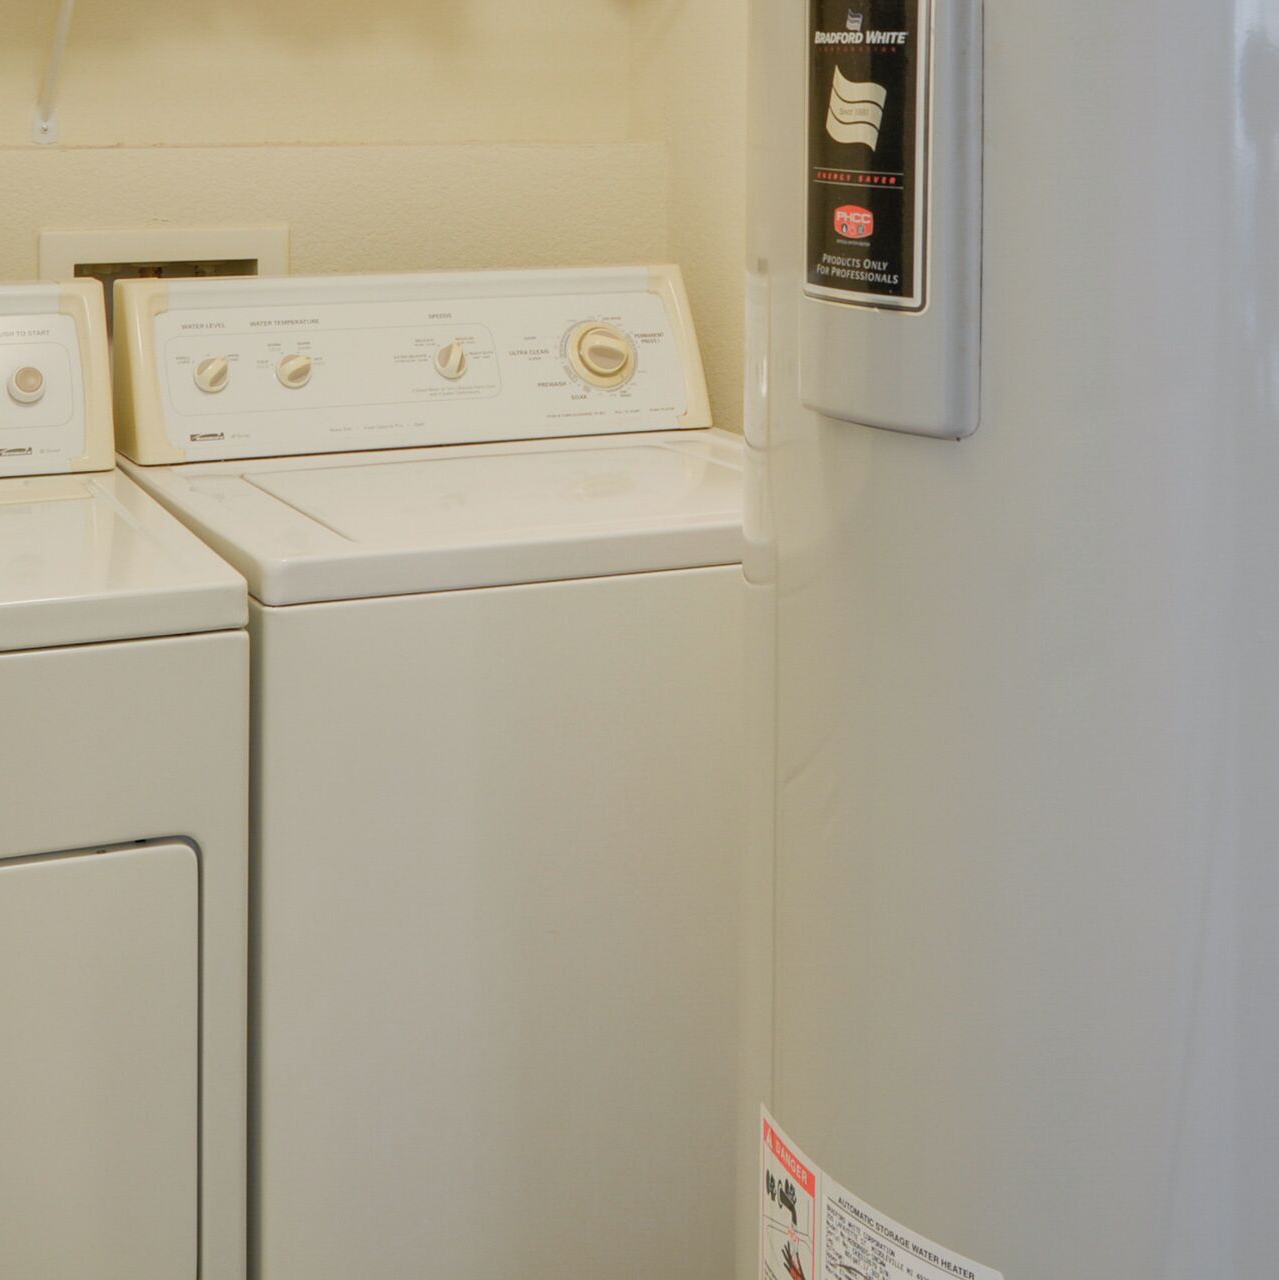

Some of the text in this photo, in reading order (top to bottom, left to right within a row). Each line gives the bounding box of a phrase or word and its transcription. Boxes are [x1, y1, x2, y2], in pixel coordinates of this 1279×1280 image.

[814, 30, 906, 45] BRADFORD WHITE
[817, 172, 896, 184] ENERGY SAVER
[836, 211, 872, 224] PHCC
[823, 253, 889, 272] PRODUCTS ONLY
[817, 264, 899, 285] FOR PROFESSIONALS
[27, 329, 50, 337] START
[181, 322, 204, 330] WATER
[775, 1142, 808, 1185] DANGER
[838, 1196, 976, 1280] AUTOMATIC STORAGE WATER HEATER
